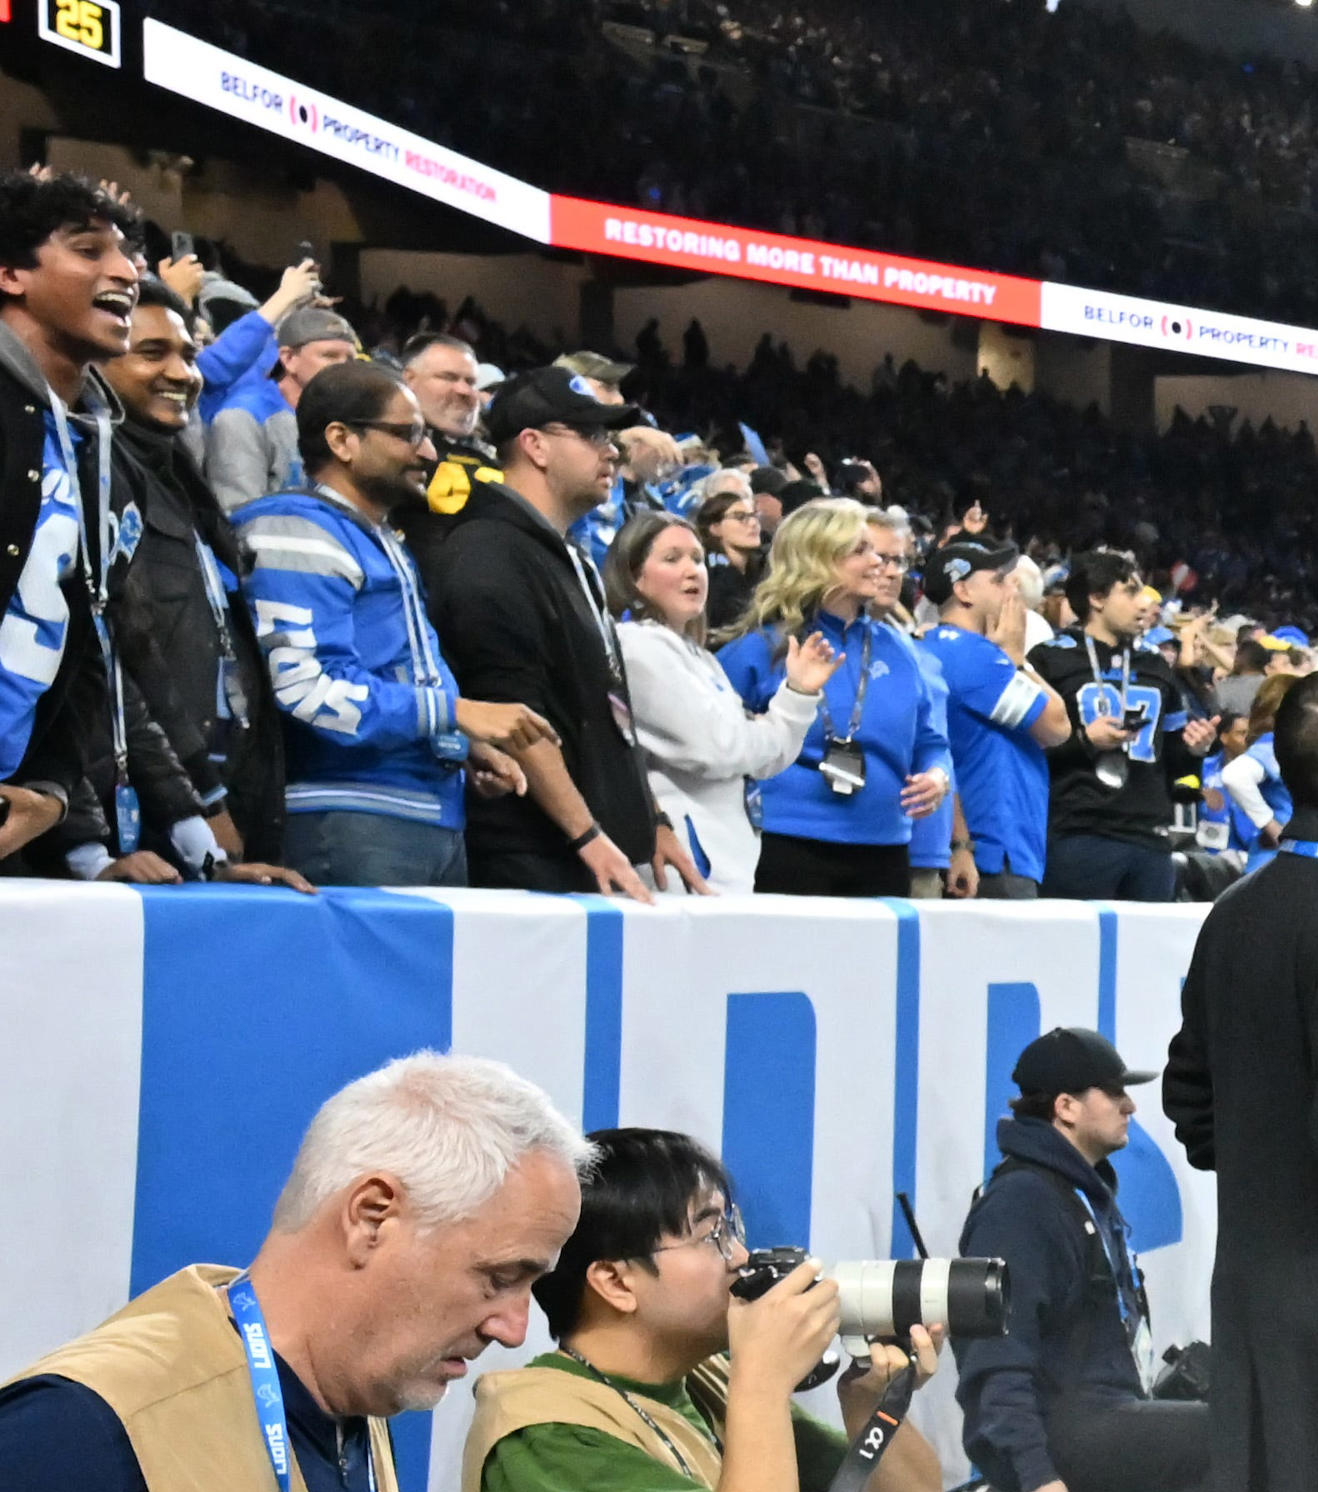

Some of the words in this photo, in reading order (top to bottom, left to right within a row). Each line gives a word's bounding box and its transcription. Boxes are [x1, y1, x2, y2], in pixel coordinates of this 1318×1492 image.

[56, 0, 102, 49] 25
[220, 70, 284, 116] BELFOR
[321, 114, 400, 164] PROPERTY
[403, 150, 498, 204] RESTORATION
[604, 218, 741, 263] RESTORING
[746, 244, 815, 275] MORE
[820, 255, 879, 285] THAN
[884, 265, 997, 305] PROPERTY
[1084, 304, 1154, 330] BELFOR
[1199, 325, 1290, 354] PROPERTY
[243, 1323, 272, 1369] LIONS
[265, 1423, 287, 1475] LIONS
